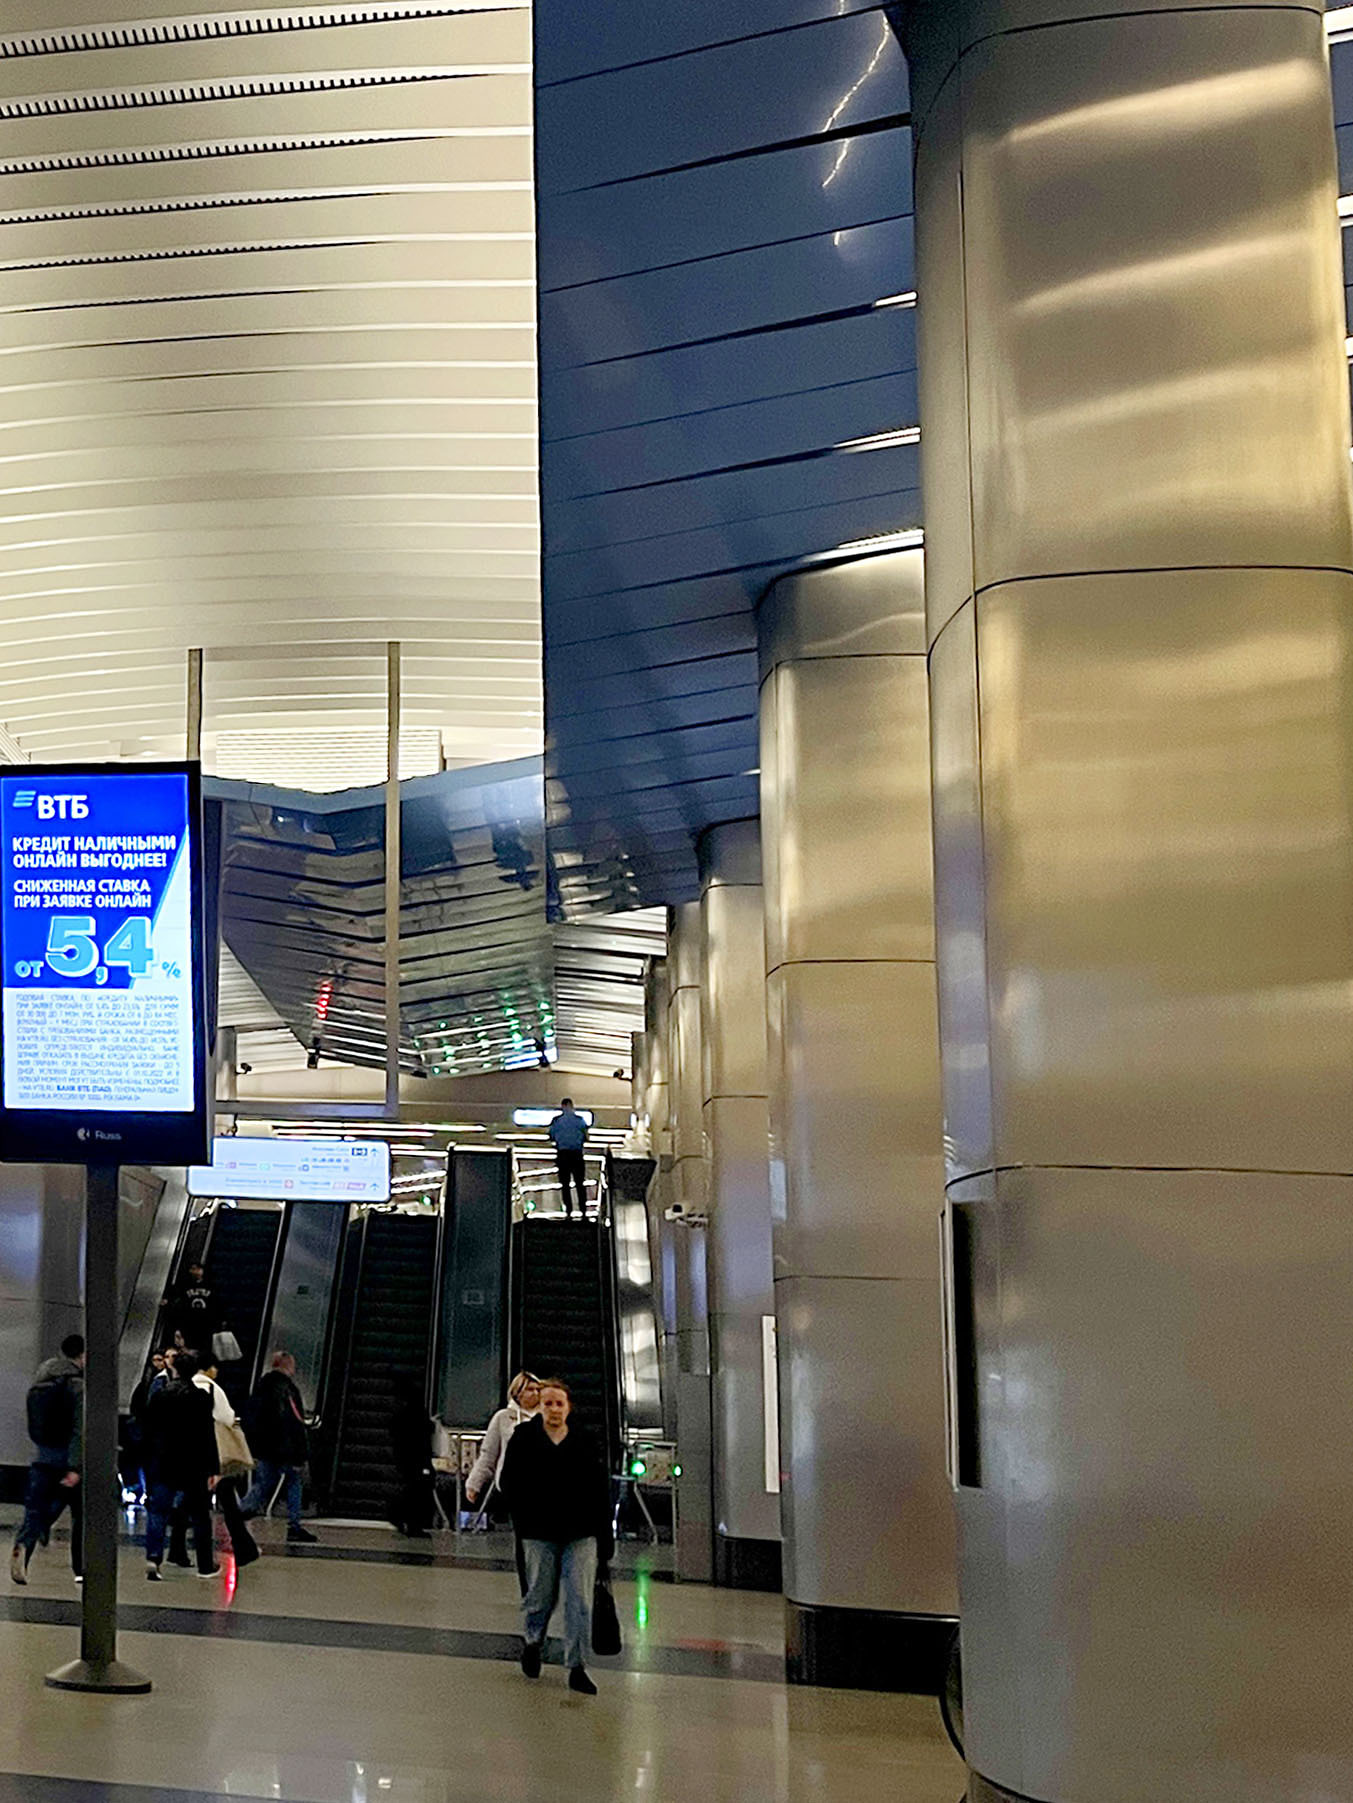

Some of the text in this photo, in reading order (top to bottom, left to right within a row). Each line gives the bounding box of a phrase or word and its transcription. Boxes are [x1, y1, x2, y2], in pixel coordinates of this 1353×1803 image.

[37, 794, 90, 820] ВТБ
[12, 834, 177, 853] КРЕДИТ НАЛИЧНЫМИ
[13, 851, 167, 870] ОНЛАЙН ВЫГОДНЕЕ!
[13, 879, 152, 893] СНИЖЕННАЯ СТАВКА
[14, 892, 152, 908] ПРИ ЗАЯВКЕ ОНЛАЙН
